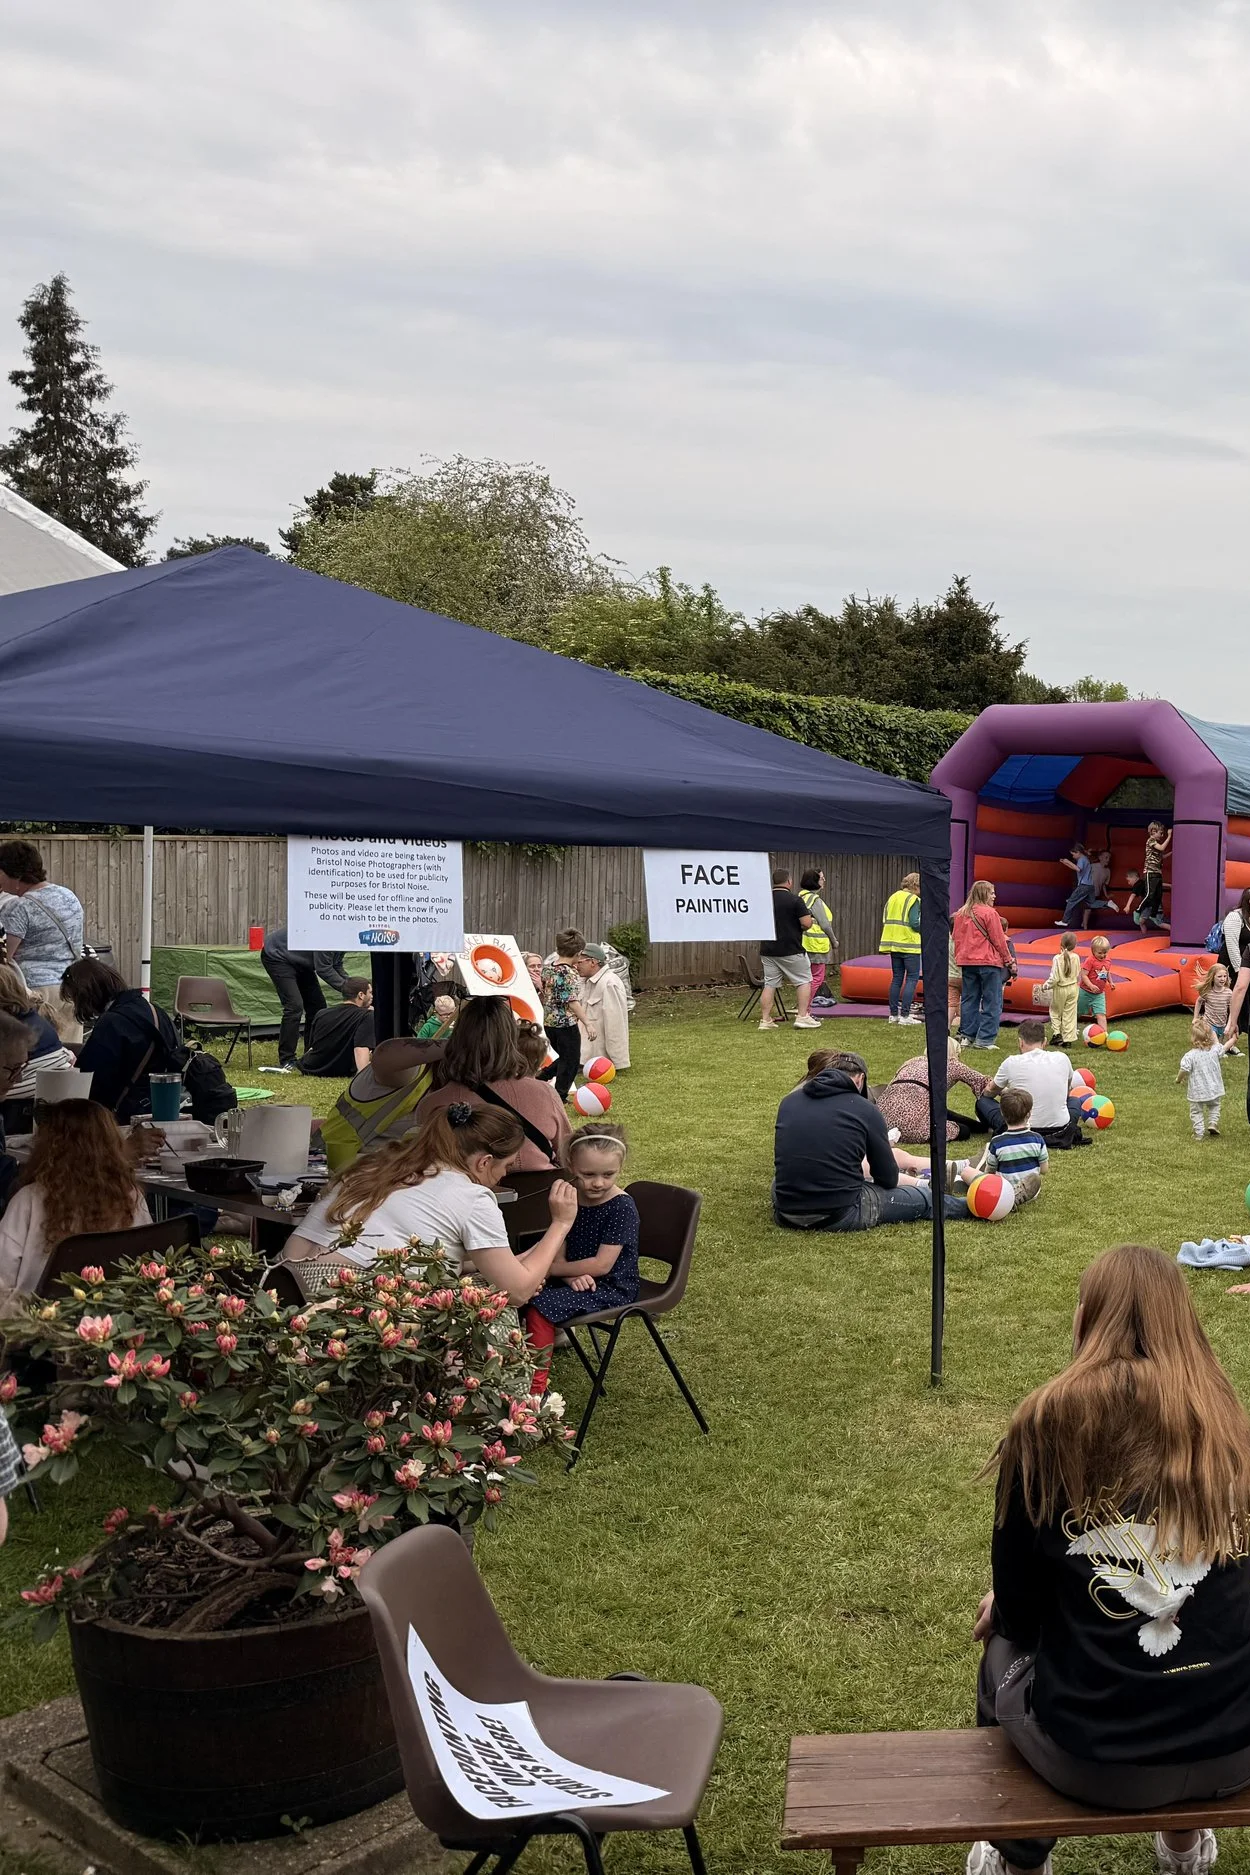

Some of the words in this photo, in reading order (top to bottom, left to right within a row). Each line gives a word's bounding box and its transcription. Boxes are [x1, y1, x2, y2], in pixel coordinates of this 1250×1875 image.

[311, 847, 339, 856] Photos
[341, 848, 355, 856] and
[358, 849, 378, 857] video
[395, 850, 414, 860] being
[416, 852, 435, 861] taken
[438, 853, 446, 862] by
[317, 858, 342, 866] Bristol
[345, 859, 366, 867] Noise
[368, 860, 422, 871] Photographers
[424, 862, 441, 872] (with
[309, 868, 363, 878] identification)
[388, 871, 404, 879] used
[407, 872, 417, 880] for
[419, 873, 448, 882] publicity
[680, 864, 740, 885] FACE
[382, 881, 405, 889] Bristol
[408, 882, 429, 890] Noise.
[304, 891, 327, 900] These
[330, 892, 343, 900] will
[346, 893, 355, 901] be
[357, 893, 375, 901] used
[378, 893, 389, 901] for
[391, 894, 414, 902] offline
[431, 896, 452, 904] online
[309, 902, 345, 911] publicity.
[348, 903, 372, 911] Please
[387, 904, 406, 912] them
[408, 905, 427, 913] know
[429, 905, 434, 913] if
[676, 899, 749, 913] PAINTING
[320, 912, 330, 921] do
[348, 913, 366, 921] wish
[378, 914, 387, 922] be
[398, 915, 410, 923] the
[412, 915, 438, 924] photos.
[424, 1671, 533, 1809] FACEPAINTING
[475, 1713, 537, 1763] HERE!
[465, 1733, 536, 1787] QUEUE
[523, 1763, 614, 1800] STARTS
